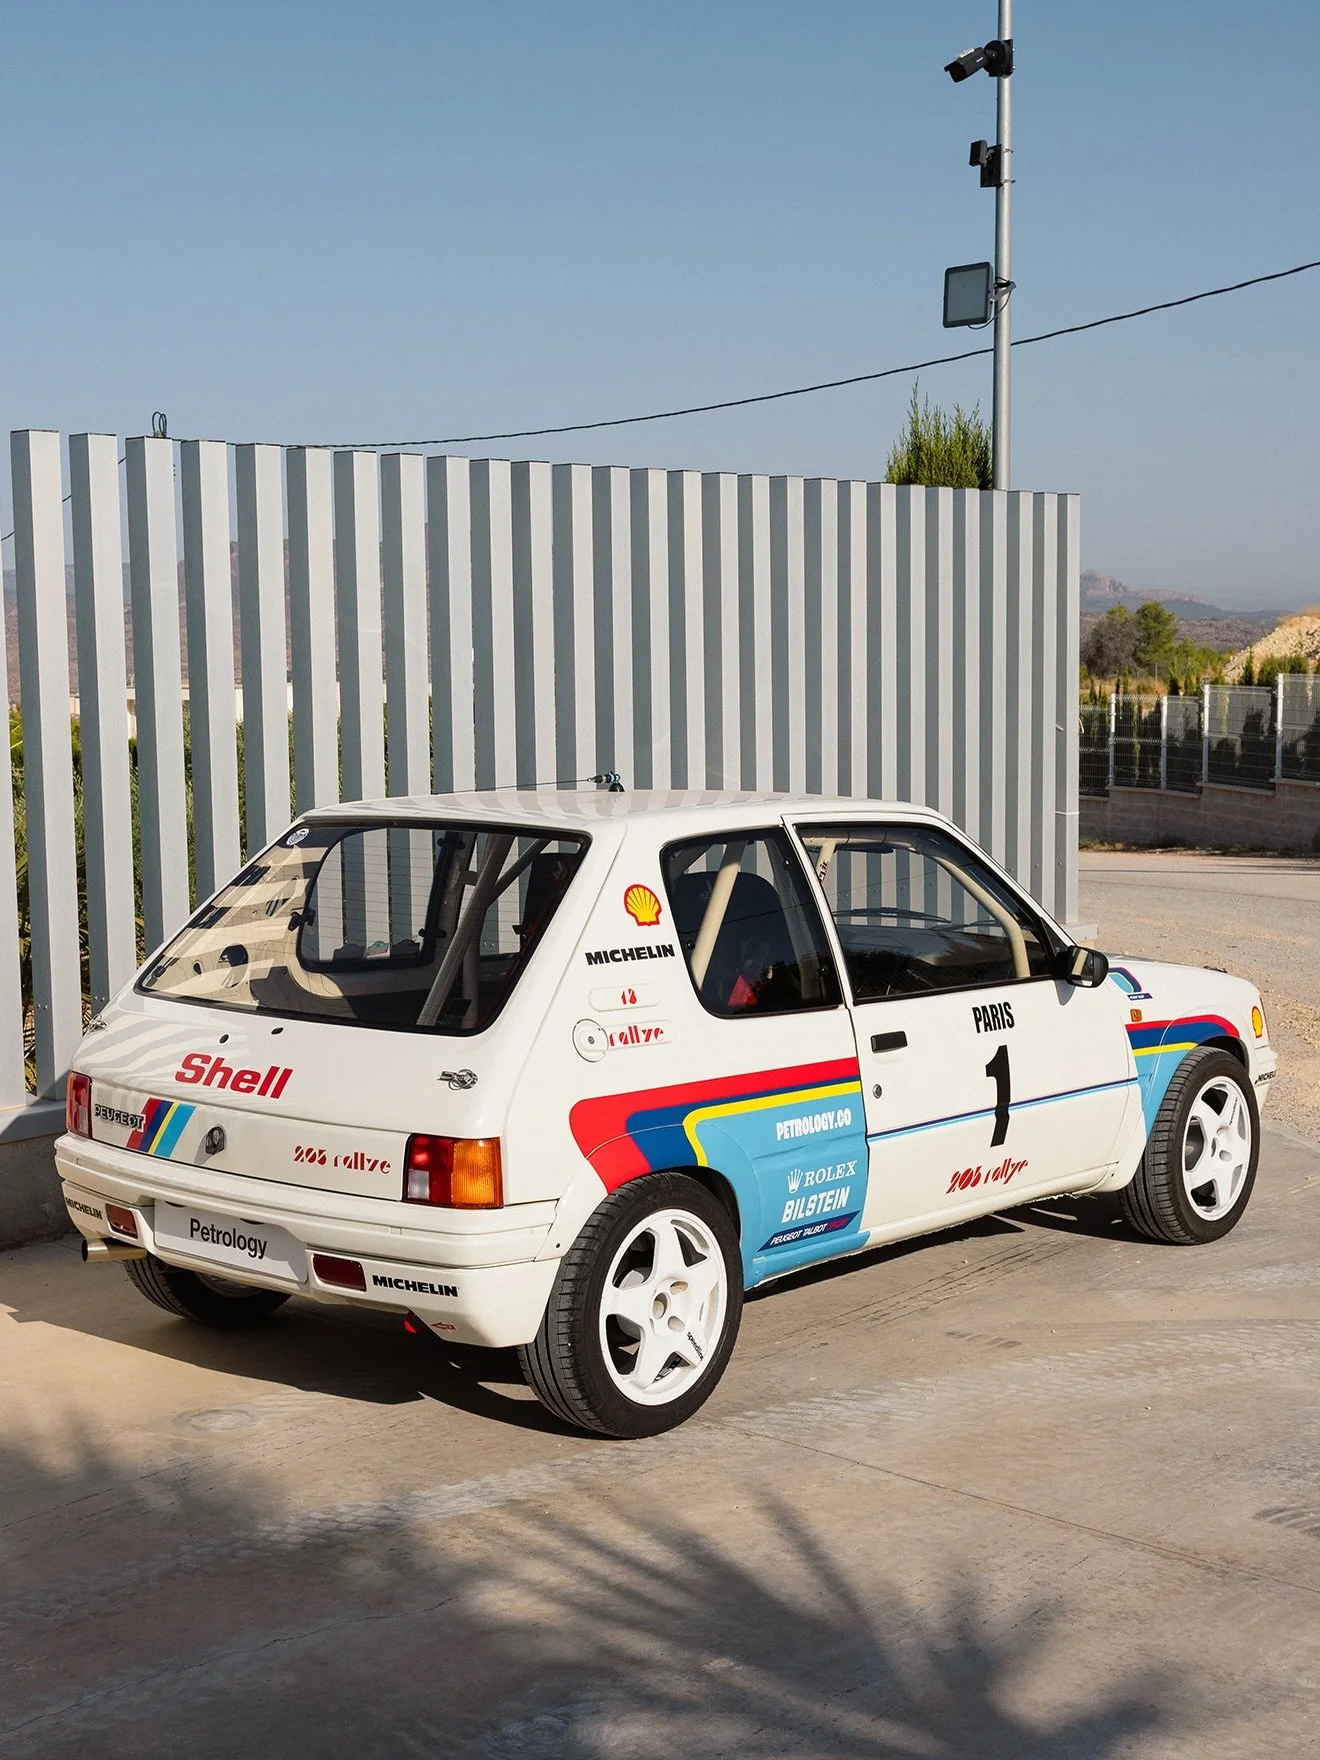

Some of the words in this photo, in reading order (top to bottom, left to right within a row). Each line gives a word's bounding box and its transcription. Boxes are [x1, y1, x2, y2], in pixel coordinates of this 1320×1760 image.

[585, 944, 675, 965] MICHELIN
[972, 1001, 1015, 1033] PARIS
[609, 1025, 664, 1047] rallye
[174, 1052, 294, 1099] Shell
[985, 1044, 1011, 1147] 1
[94, 1103, 144, 1130] PEUGEOT
[776, 1108, 852, 1141] PETROLOGY.CO
[293, 1145, 327, 1166] 205
[333, 1151, 391, 1174] rallye
[803, 1160, 858, 1188] ROLEX
[945, 1165, 982, 1195] 205
[65, 1197, 102, 1220] MICHELIN
[781, 1186, 851, 1224] BILSTEIN
[189, 1218, 268, 1260] Petrology
[770, 1230, 803, 1246] PEUGEOT
[802, 1223, 829, 1238] TALBOT
[372, 1274, 458, 1297] MICHELIN
